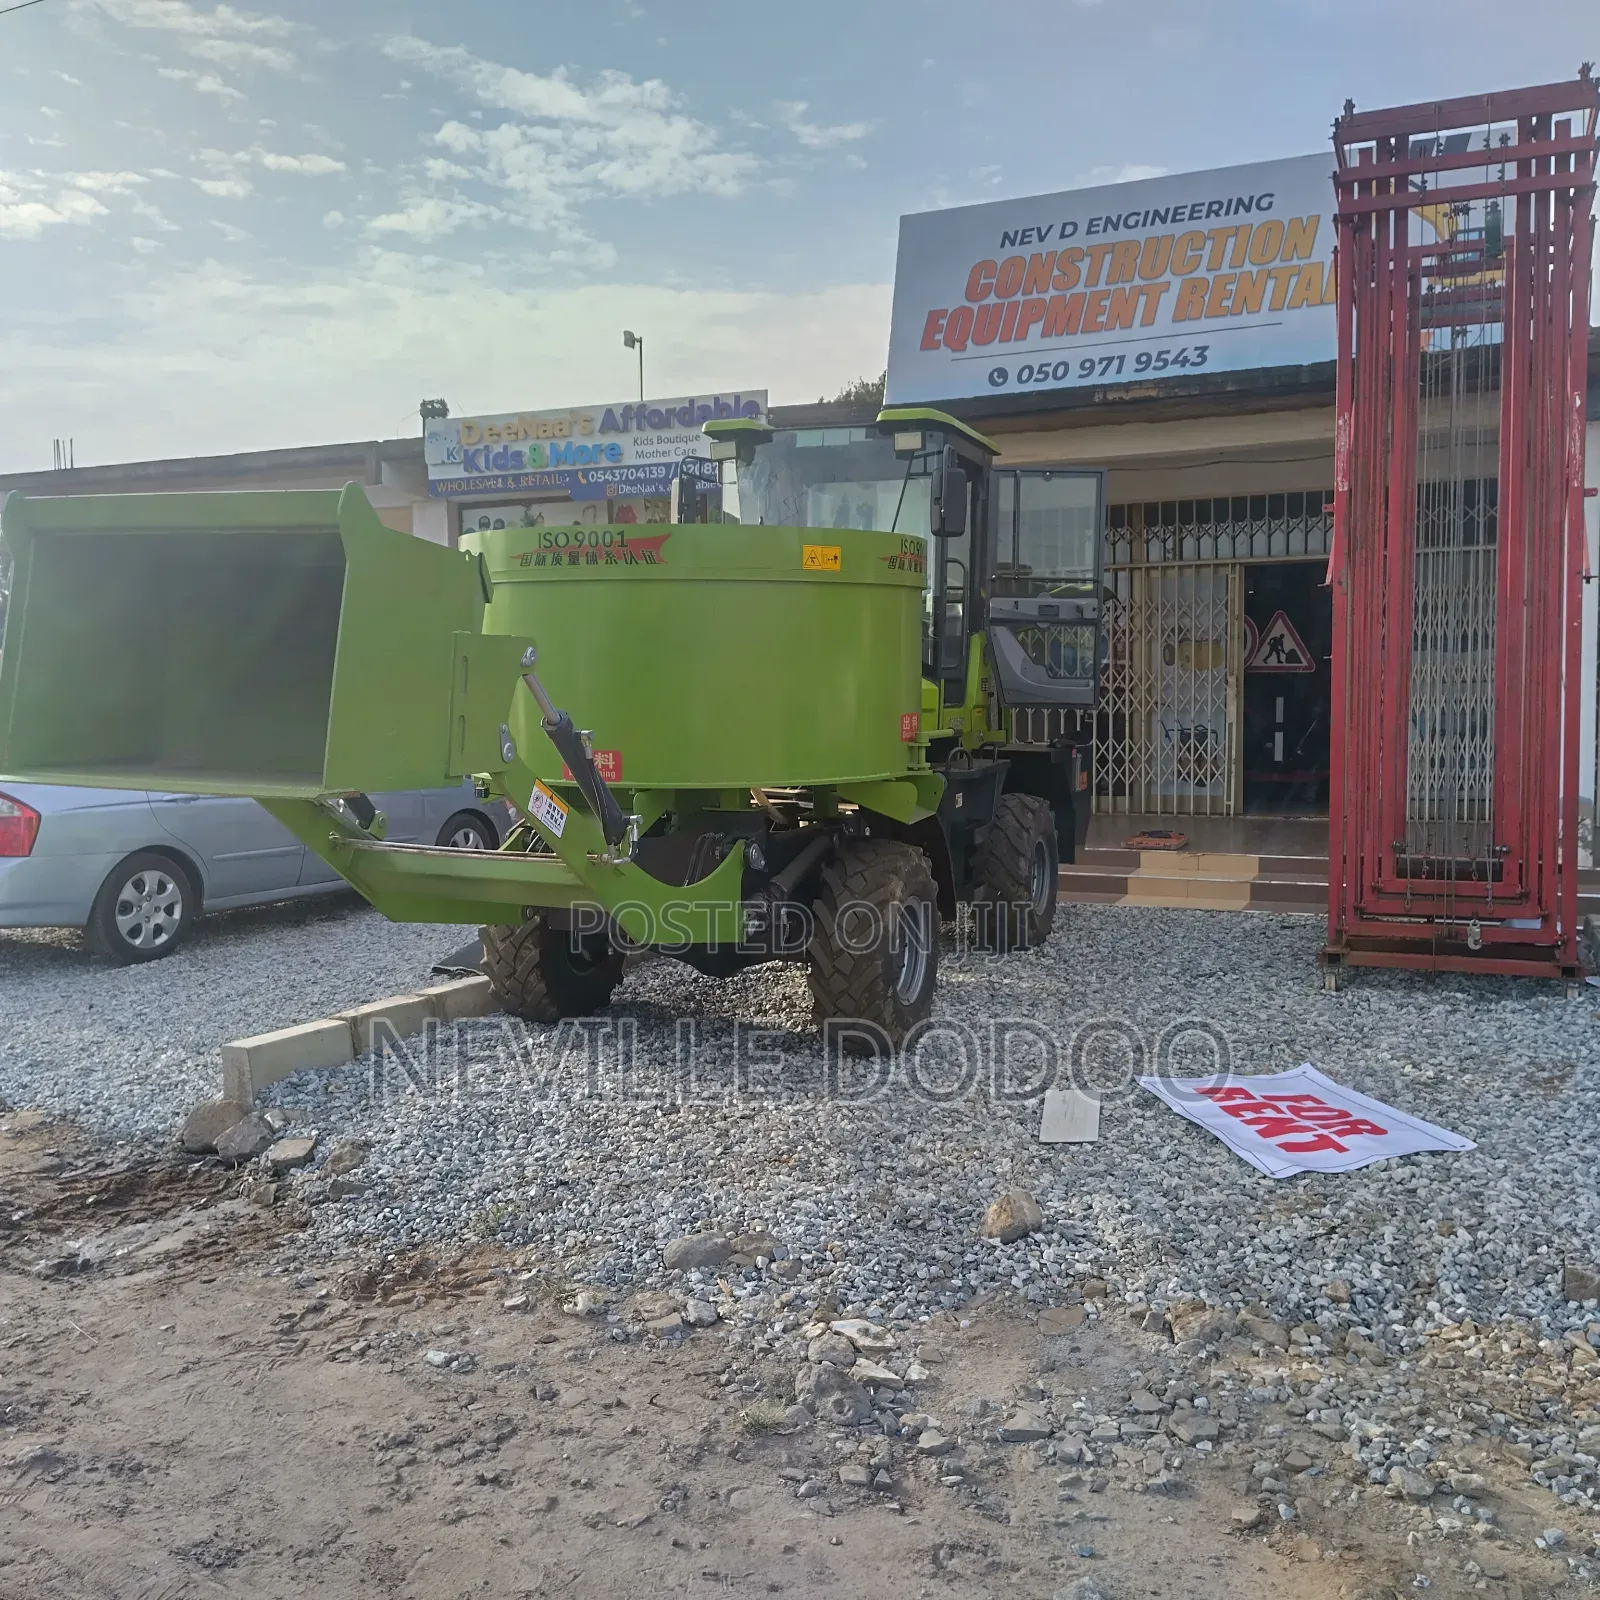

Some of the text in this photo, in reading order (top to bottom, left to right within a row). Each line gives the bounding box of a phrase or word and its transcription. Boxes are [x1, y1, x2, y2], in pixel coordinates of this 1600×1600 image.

[1000, 192, 1275, 250] NEV D ENGINEERING
[965, 215, 1321, 303] CONSTRUCTION
[919, 281, 1171, 352] EQUIPMENT
[1016, 345, 1210, 386] 050 971 9543
[460, 395, 761, 447] DeeNaa's Affordable
[633, 434, 701, 447] Kids Boutique
[588, 465, 666, 483] 0543704139
[635, 447, 698, 460] Mother Care
[436, 473, 561, 493] WHOLESALE & RETAIL
[519, 549, 661, 567] 国际质量体系认证
[1192, 1086, 1351, 1154] RENT
[1259, 1093, 1389, 1138] FOR
